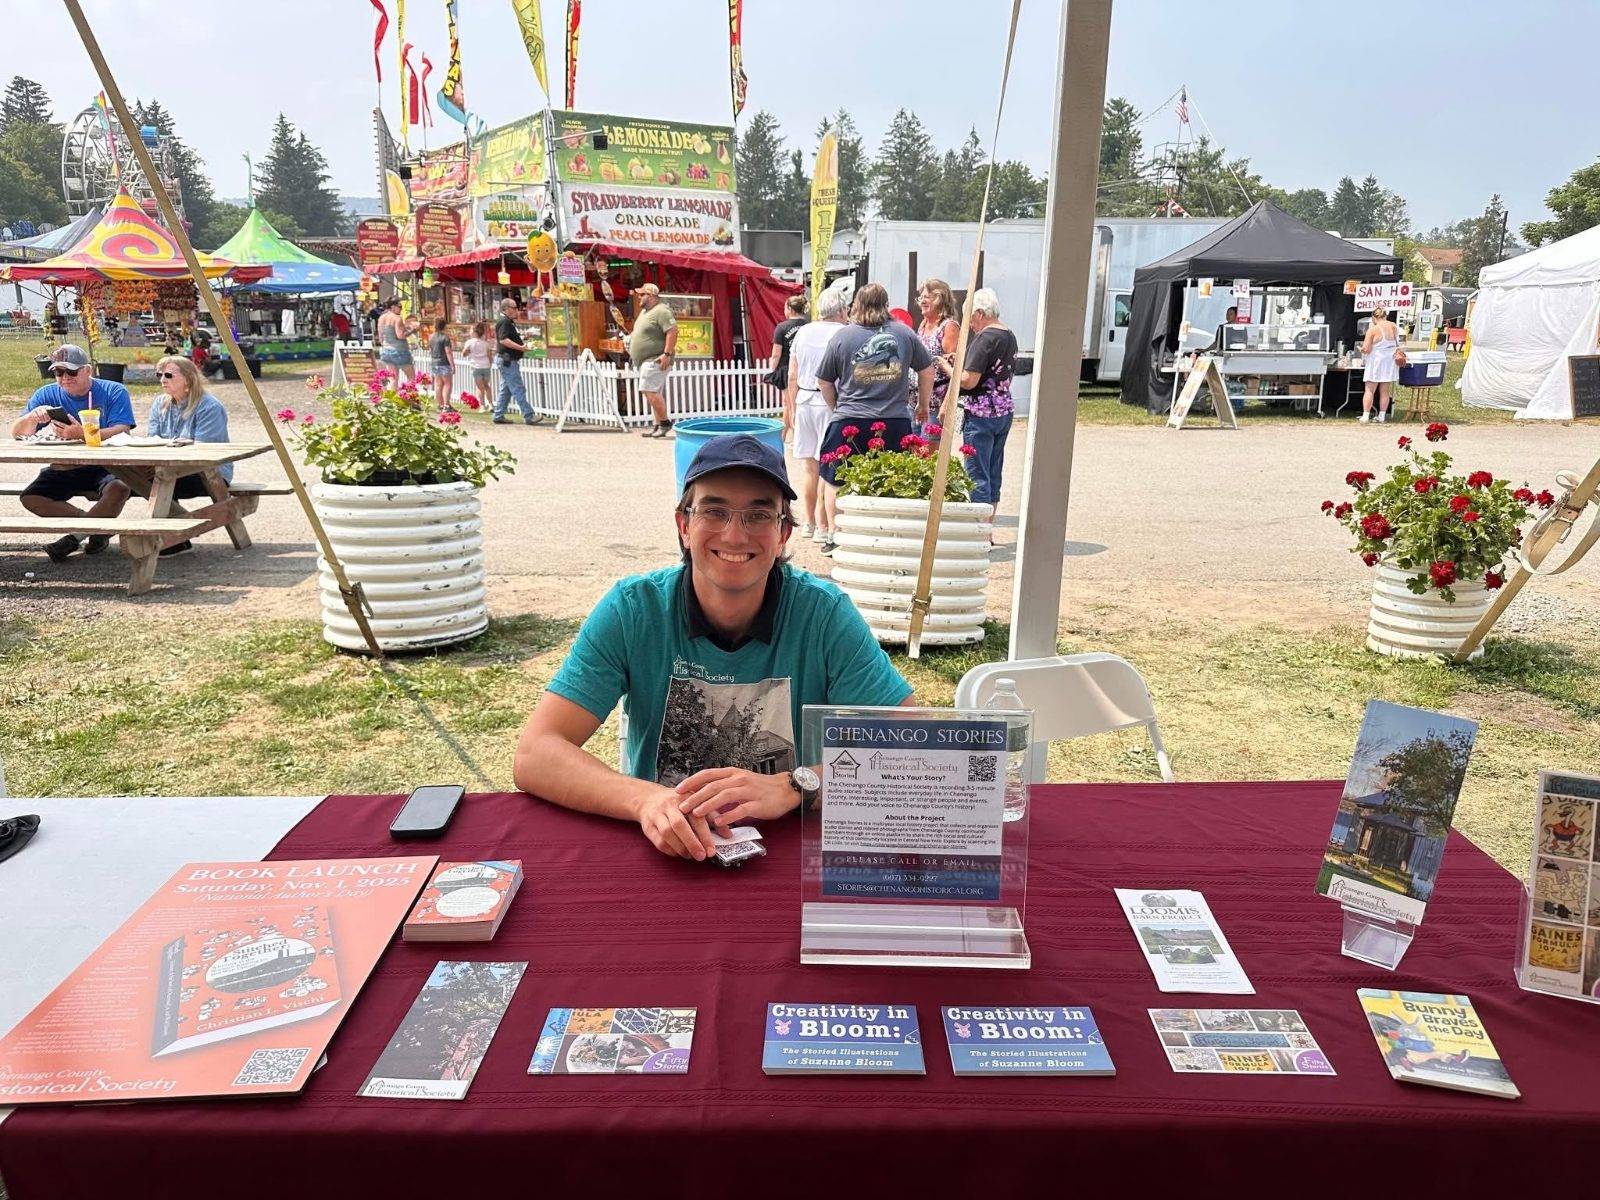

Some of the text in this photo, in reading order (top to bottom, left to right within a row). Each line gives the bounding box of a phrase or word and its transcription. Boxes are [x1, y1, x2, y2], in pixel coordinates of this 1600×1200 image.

[602, 126, 692, 150] LEMONADE
[570, 190, 732, 222] STRAWBERRY LEMONADE
[615, 214, 700, 228] ORANGEADE
[609, 228, 710, 244] PEACH LEMONADE
[1358, 285, 1409, 297] SAN HO
[825, 726, 1004, 744] CHENANGO STORIES
[922, 760, 958, 773] Society
[188, 862, 418, 881] BOOK LAUNCH
[282, 880, 328, 891] Nov.
[356, 877, 412, 888] 2025
[1532, 926, 1581, 941] GAINES
[233, 939, 288, 955] Stitched
[1533, 935, 1578, 948] FORMULA
[1538, 945, 1568, 954] 107-A
[772, 1005, 909, 1021] Creativity in
[948, 1008, 1086, 1023] Creativity in
[1403, 1002, 1467, 1019] Bunny
[197, 1012, 263, 1032] Christian
[1422, 1014, 1478, 1028] Braves
[799, 1020, 900, 1038] Bloom:
[978, 1023, 1083, 1039] Bloom:
[1428, 1025, 1484, 1040] the Day
[652, 1060, 688, 1070] Stories
[662, 1052, 688, 1064] Fifty
[0, 1068, 107, 1081] henango County
[89, 1076, 177, 1092] Society
[420, 1088, 456, 1097] Society
